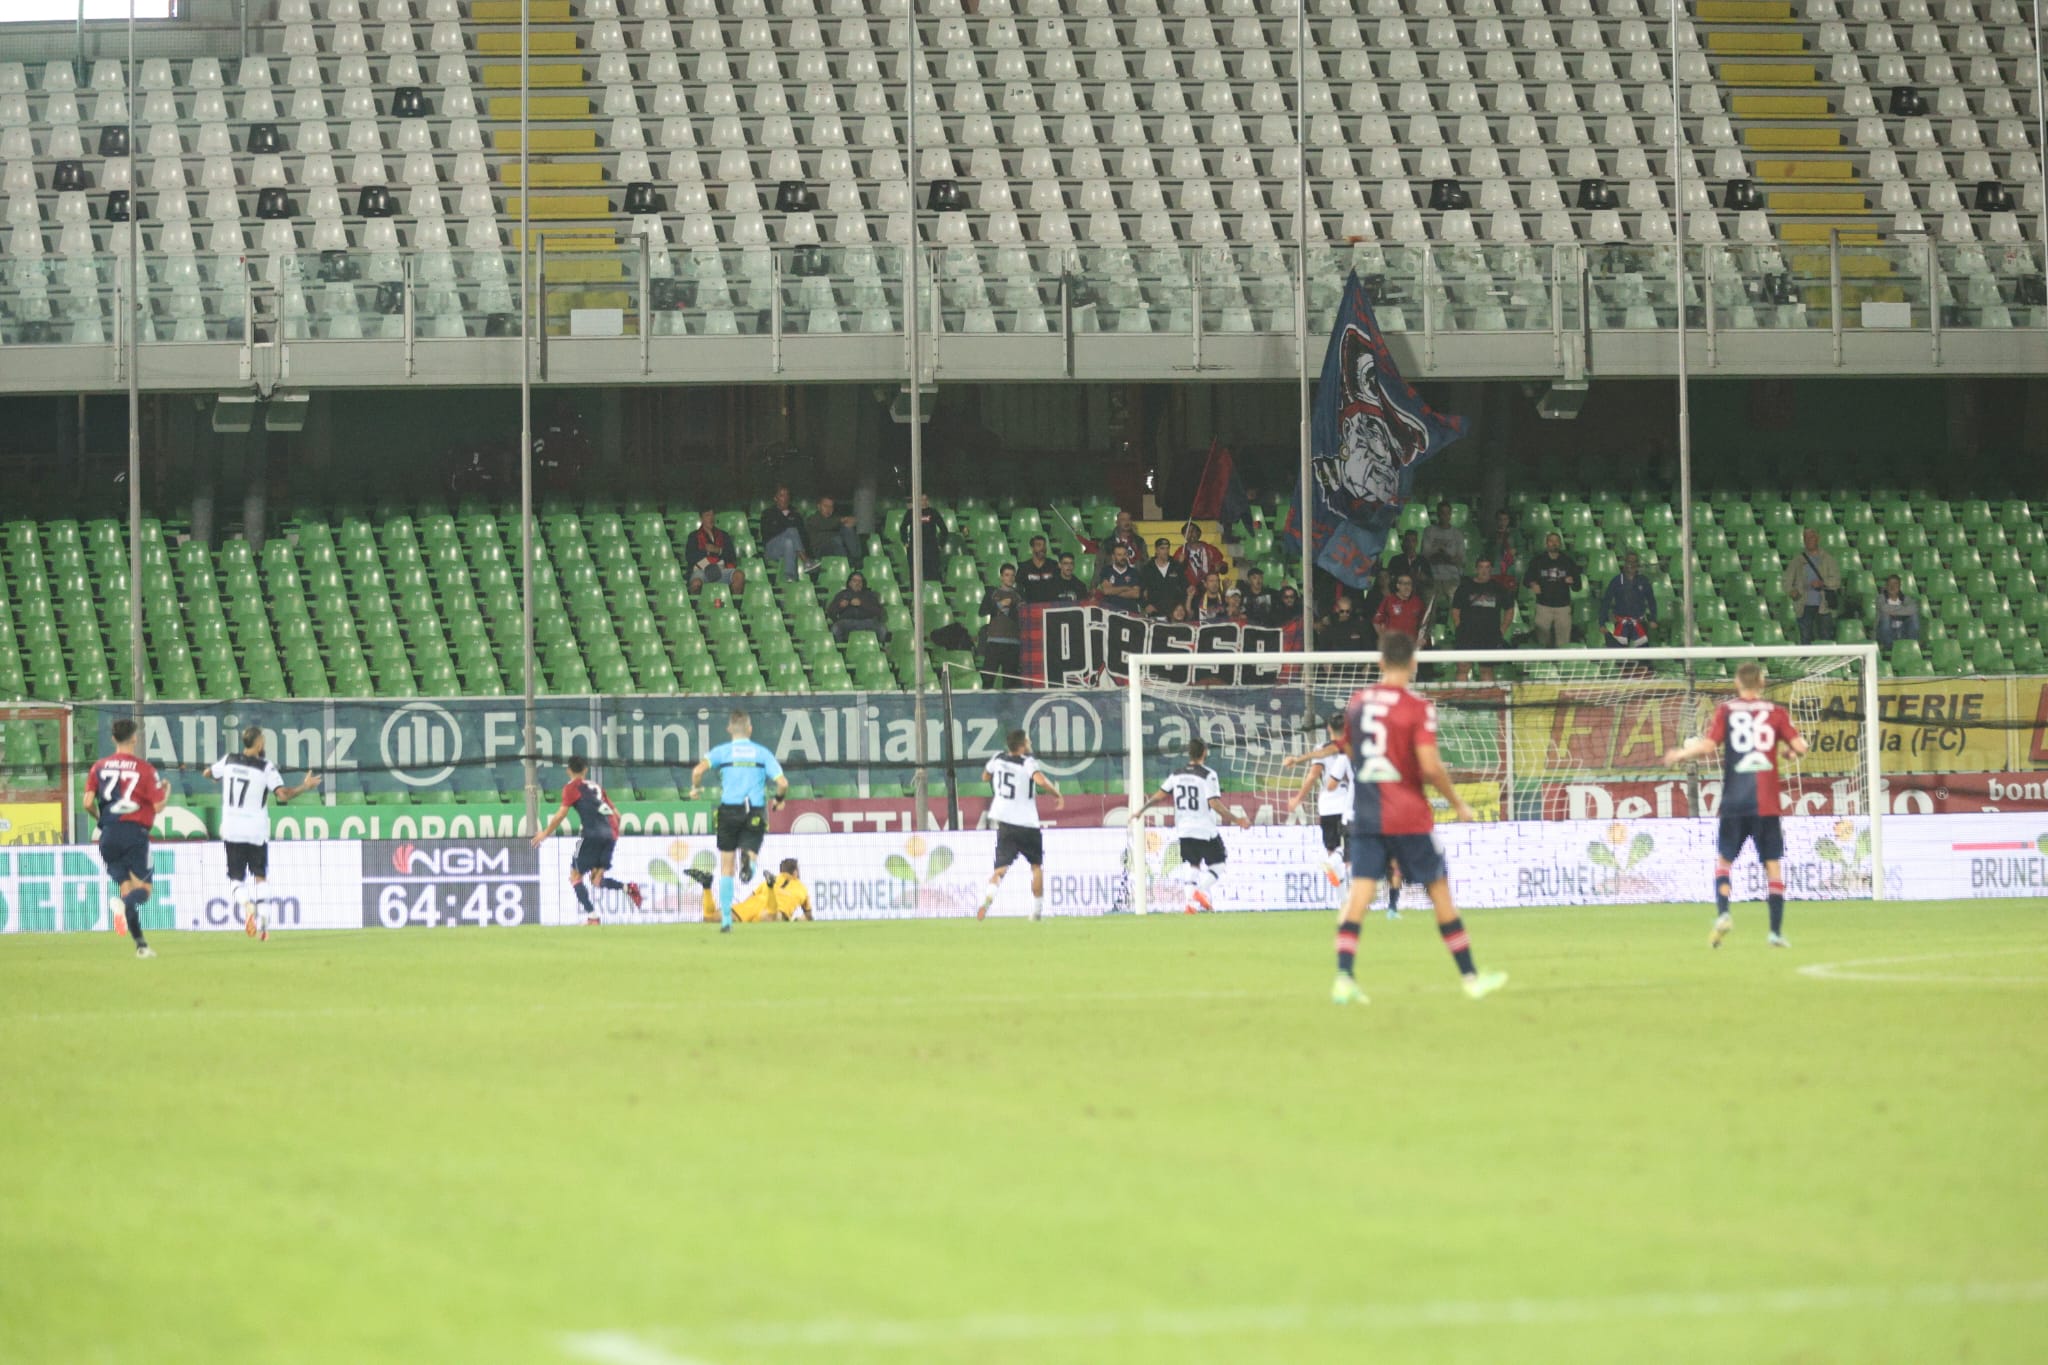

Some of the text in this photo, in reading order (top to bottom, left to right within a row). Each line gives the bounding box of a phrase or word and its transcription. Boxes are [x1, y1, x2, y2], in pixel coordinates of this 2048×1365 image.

[484, 708, 710, 769] Fantini
[775, 706, 999, 763] Allianz
[1361, 704, 1389, 757] 5
[1729, 709, 1776, 752] 86
[1911, 727, 1966, 757] (FC)
[100, 769, 140, 801] 77
[229, 777, 250, 808] 17
[998, 771, 1015, 800] 15
[1177, 785, 1199, 811] 28
[408, 847, 509, 873] NGM
[379, 883, 525, 927] 64:48
